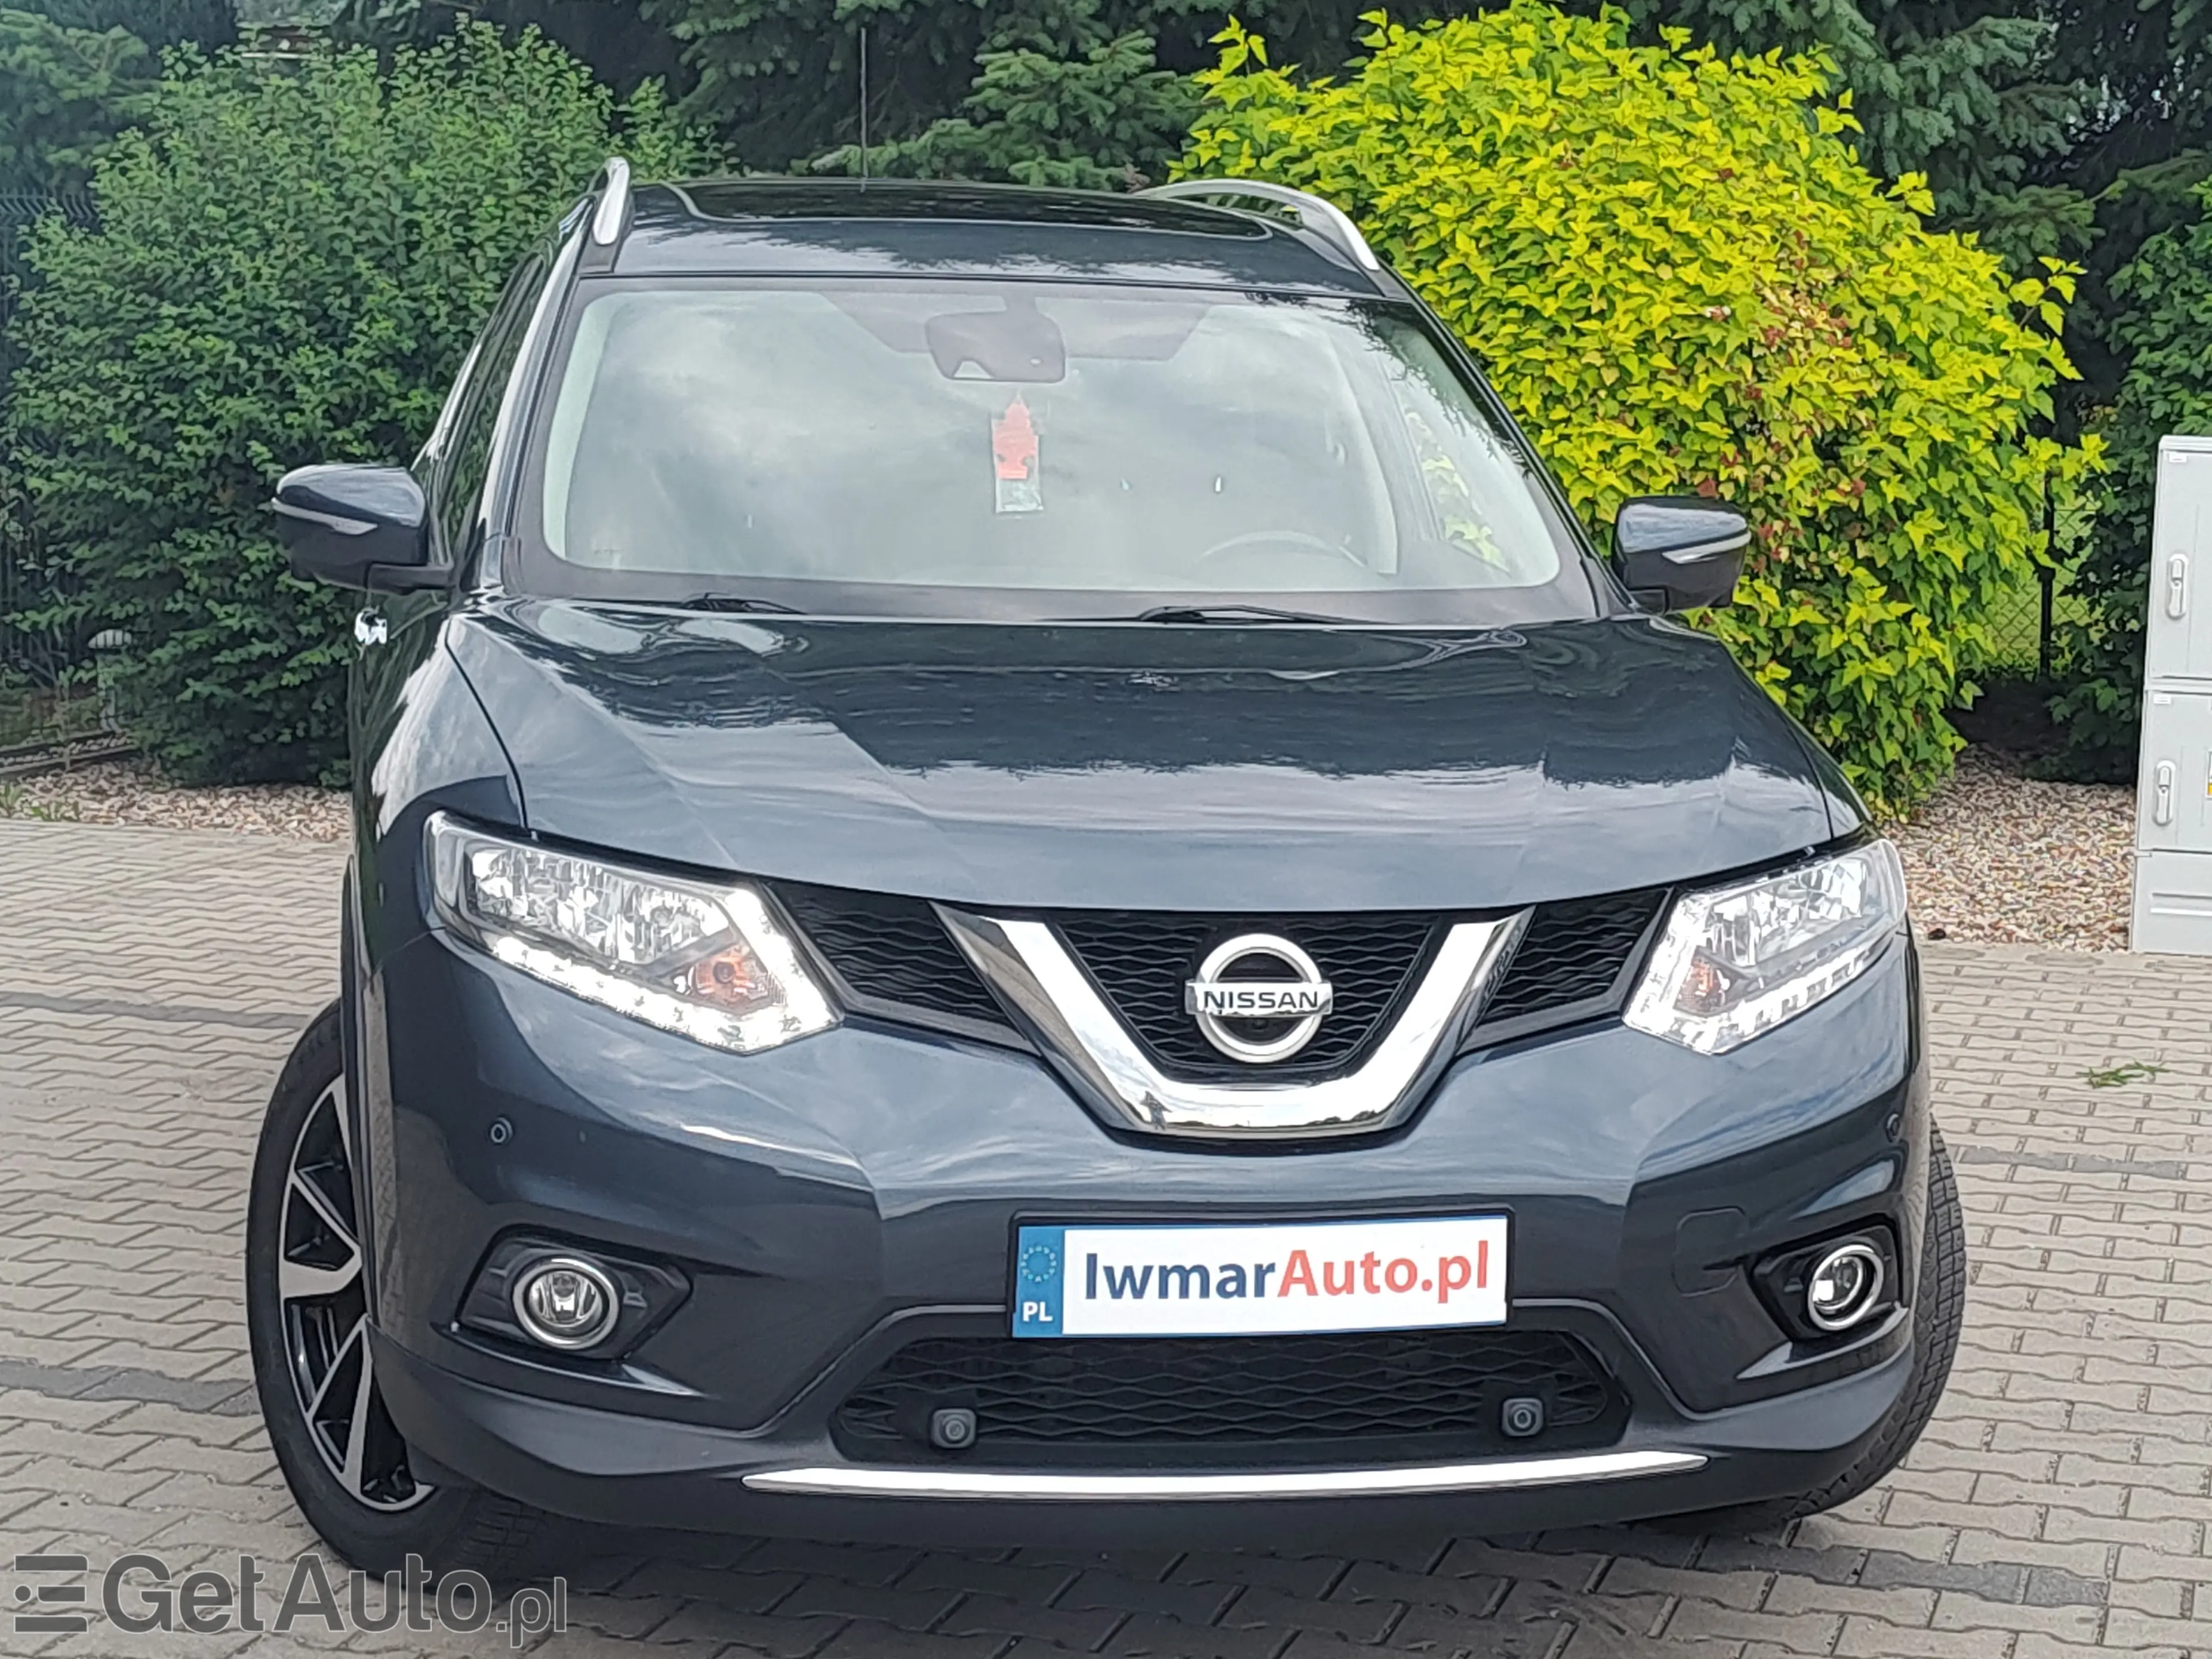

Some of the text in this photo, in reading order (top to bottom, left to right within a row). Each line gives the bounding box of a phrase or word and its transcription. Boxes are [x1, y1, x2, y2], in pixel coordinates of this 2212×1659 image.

[1203, 990, 1318, 1009] NISSAN
[1085, 1239, 1488, 1304] IwmarAuto.pl
[1022, 1301, 1053, 1322] PL
